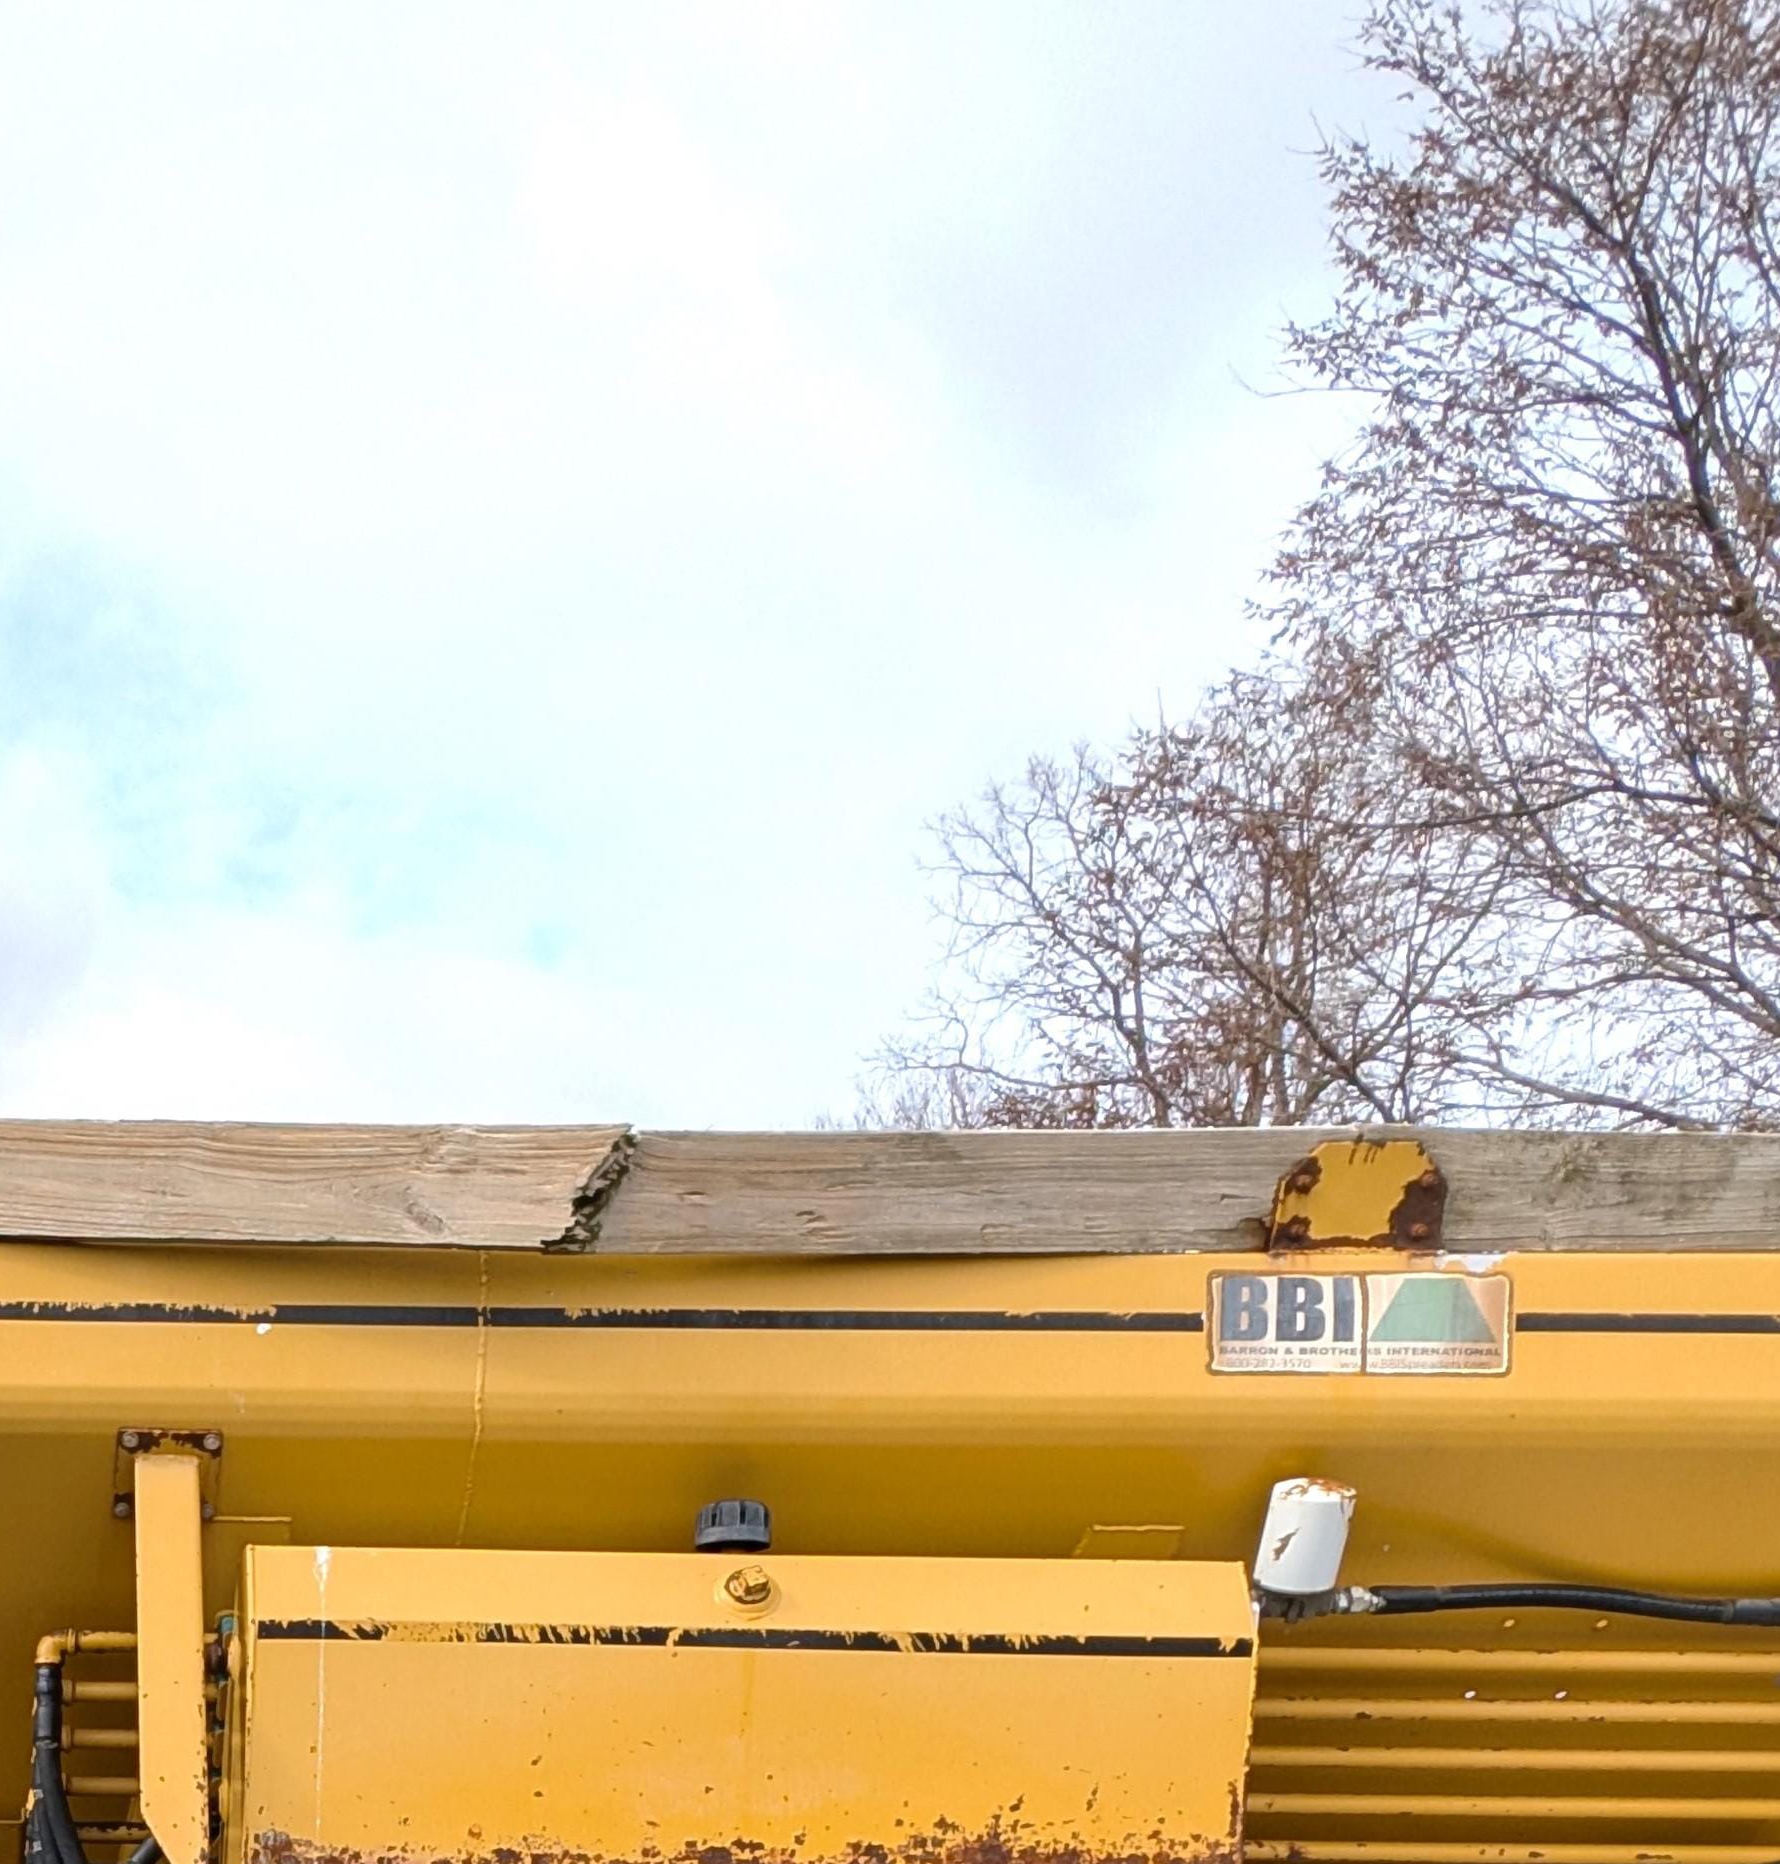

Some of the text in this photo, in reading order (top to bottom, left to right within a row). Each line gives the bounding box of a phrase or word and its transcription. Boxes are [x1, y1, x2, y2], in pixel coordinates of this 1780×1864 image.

[1221, 1276, 1355, 1342] BBI
[1220, 1346, 1278, 1355] BARRON
[1284, 1346, 1294, 1355] &
[1386, 1347, 1501, 1357] INTERNATIONAL
